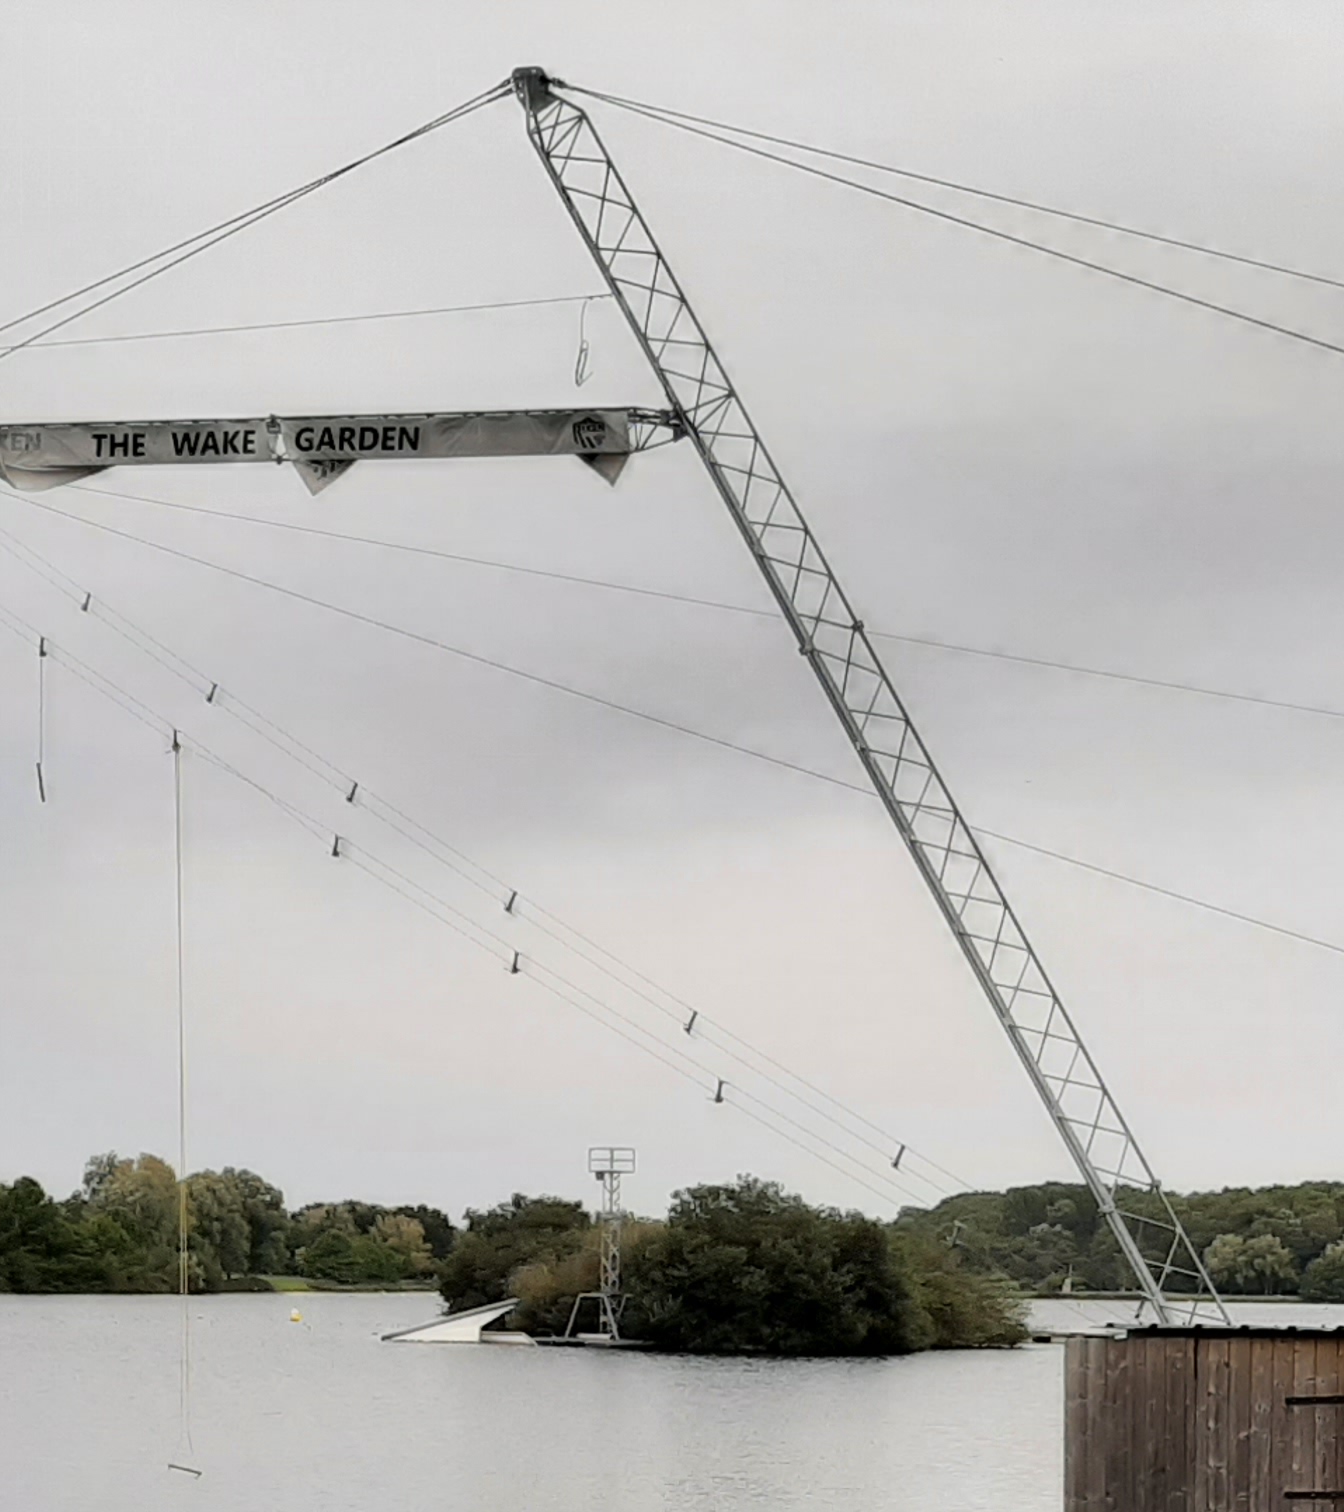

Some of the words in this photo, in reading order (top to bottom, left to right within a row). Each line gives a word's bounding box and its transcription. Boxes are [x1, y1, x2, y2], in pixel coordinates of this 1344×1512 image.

[92, 433, 146, 457] THE
[172, 430, 256, 456] WAKE
[294, 426, 420, 452] GARDEN
